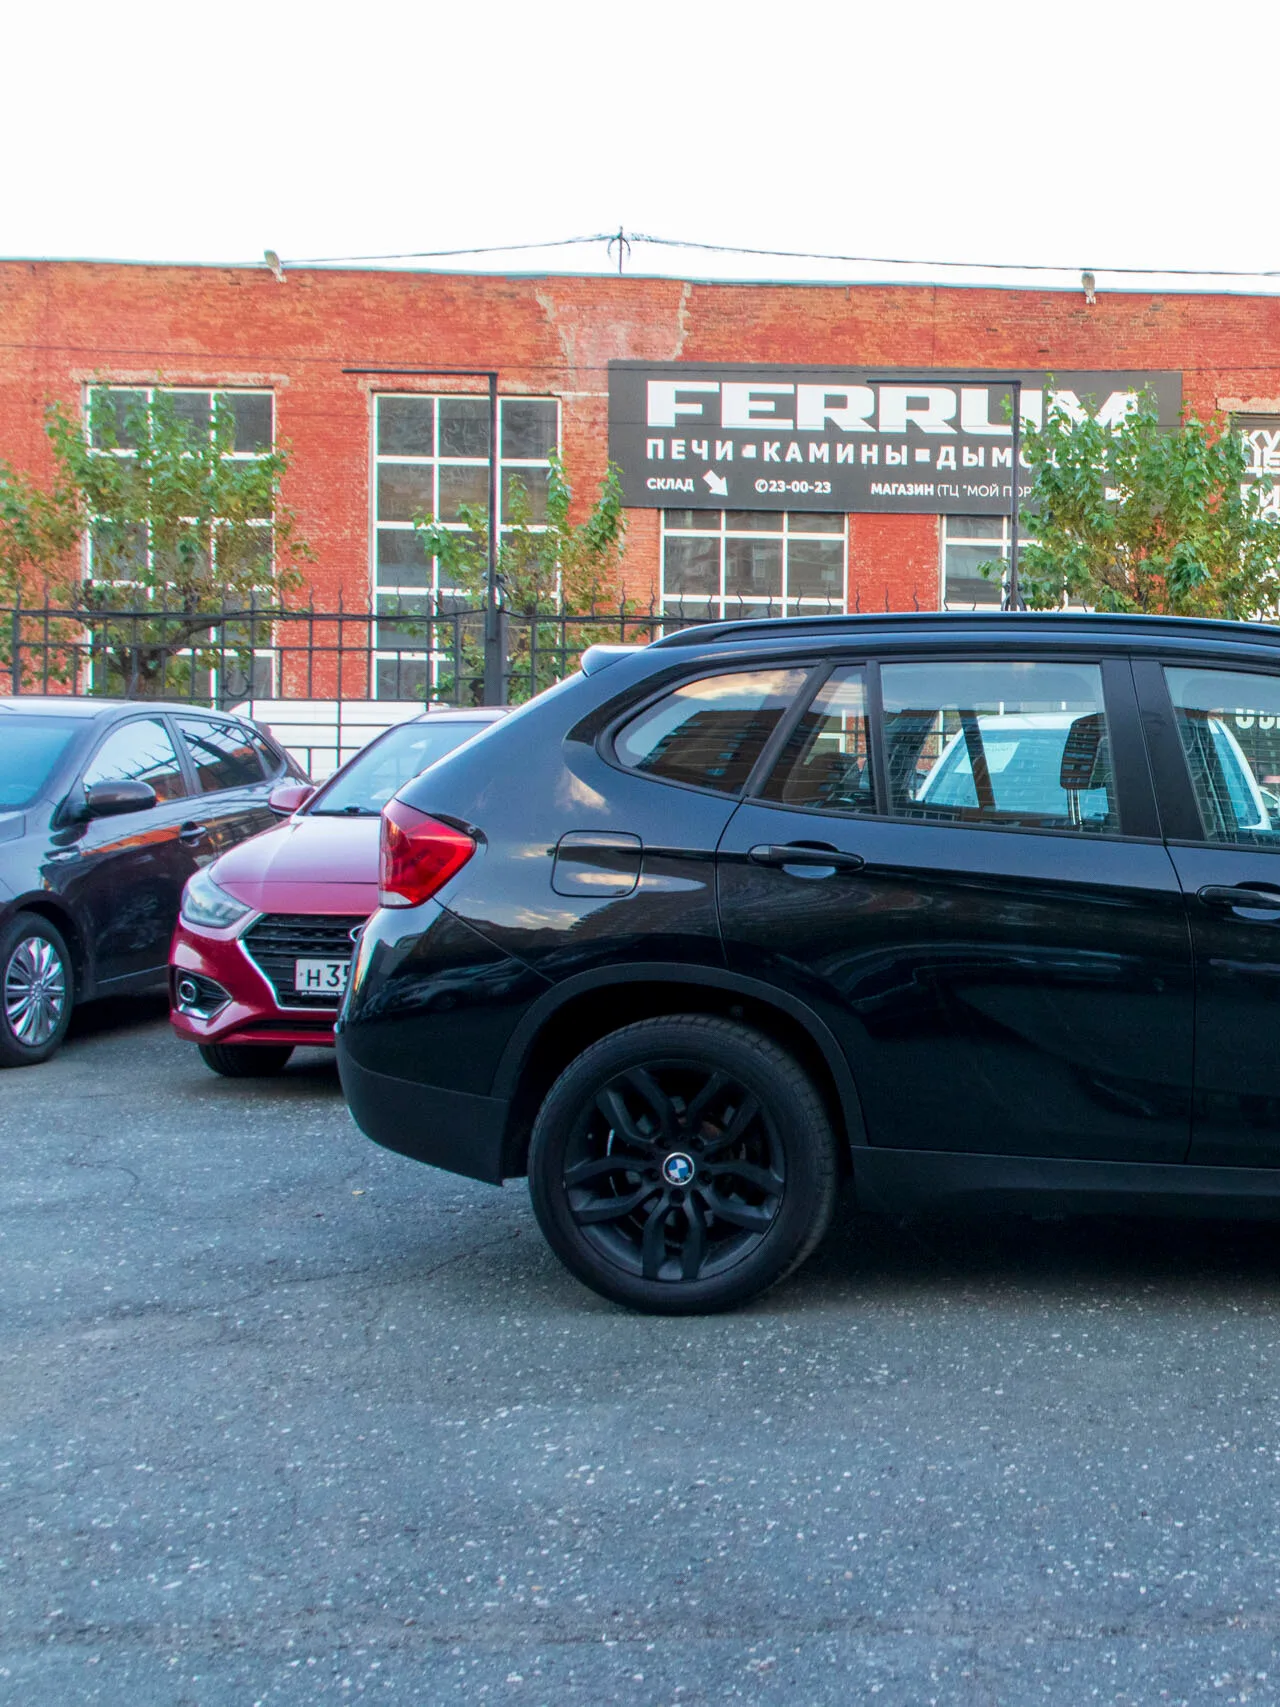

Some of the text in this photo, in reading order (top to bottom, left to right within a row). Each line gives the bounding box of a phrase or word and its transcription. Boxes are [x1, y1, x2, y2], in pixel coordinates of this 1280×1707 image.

[647, 380, 1139, 438] FERRUM
[646, 438, 734, 461] ПЕЧИ
[763, 441, 908, 466] КАМИНЫ
[646, 478, 694, 493] СКЛАД
[769, 480, 832, 494] 23-00-23
[870, 482, 934, 497] МАГАЗИН
[937, 484, 959, 499] (ТЦ
